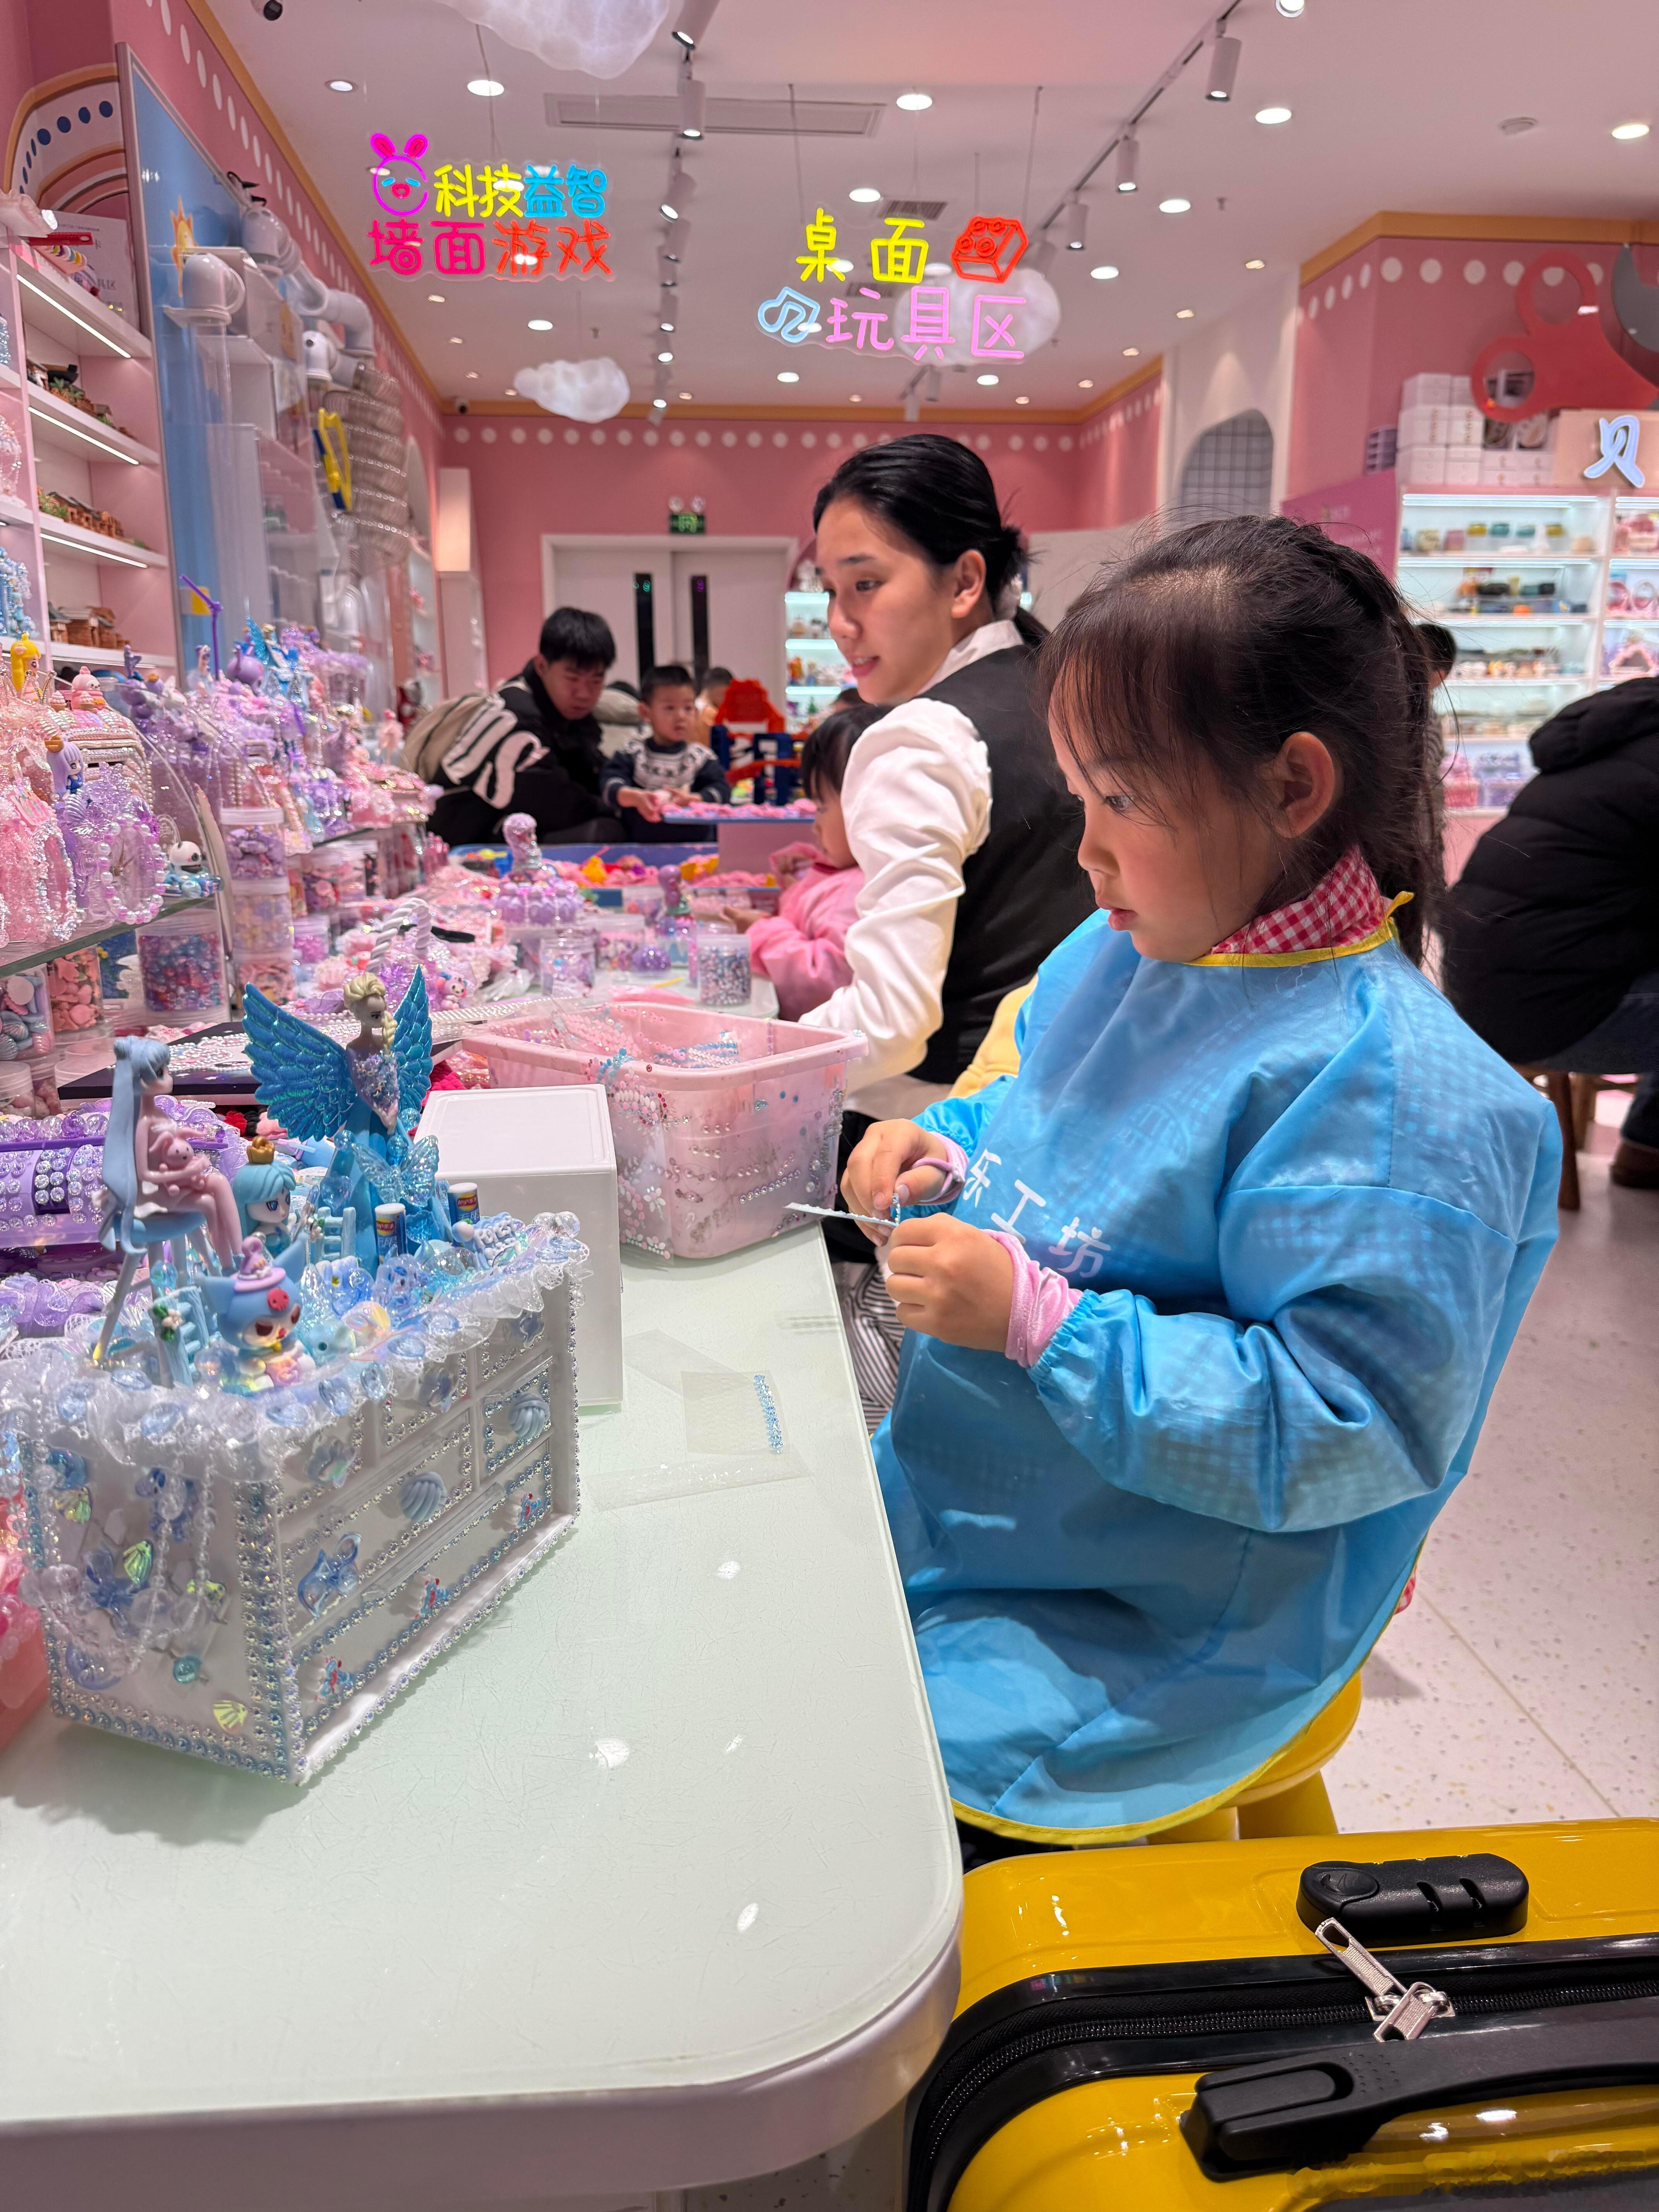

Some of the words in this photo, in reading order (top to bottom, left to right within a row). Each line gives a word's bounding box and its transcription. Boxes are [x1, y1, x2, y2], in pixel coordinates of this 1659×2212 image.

[434, 164, 608, 218] 科技益智
[366, 218, 612, 276] 墙面游戏
[795, 208, 929, 284] 桌面
[826, 285, 1027, 360] 玩具区
[962, 1148, 1111, 1278] 乐工坊
